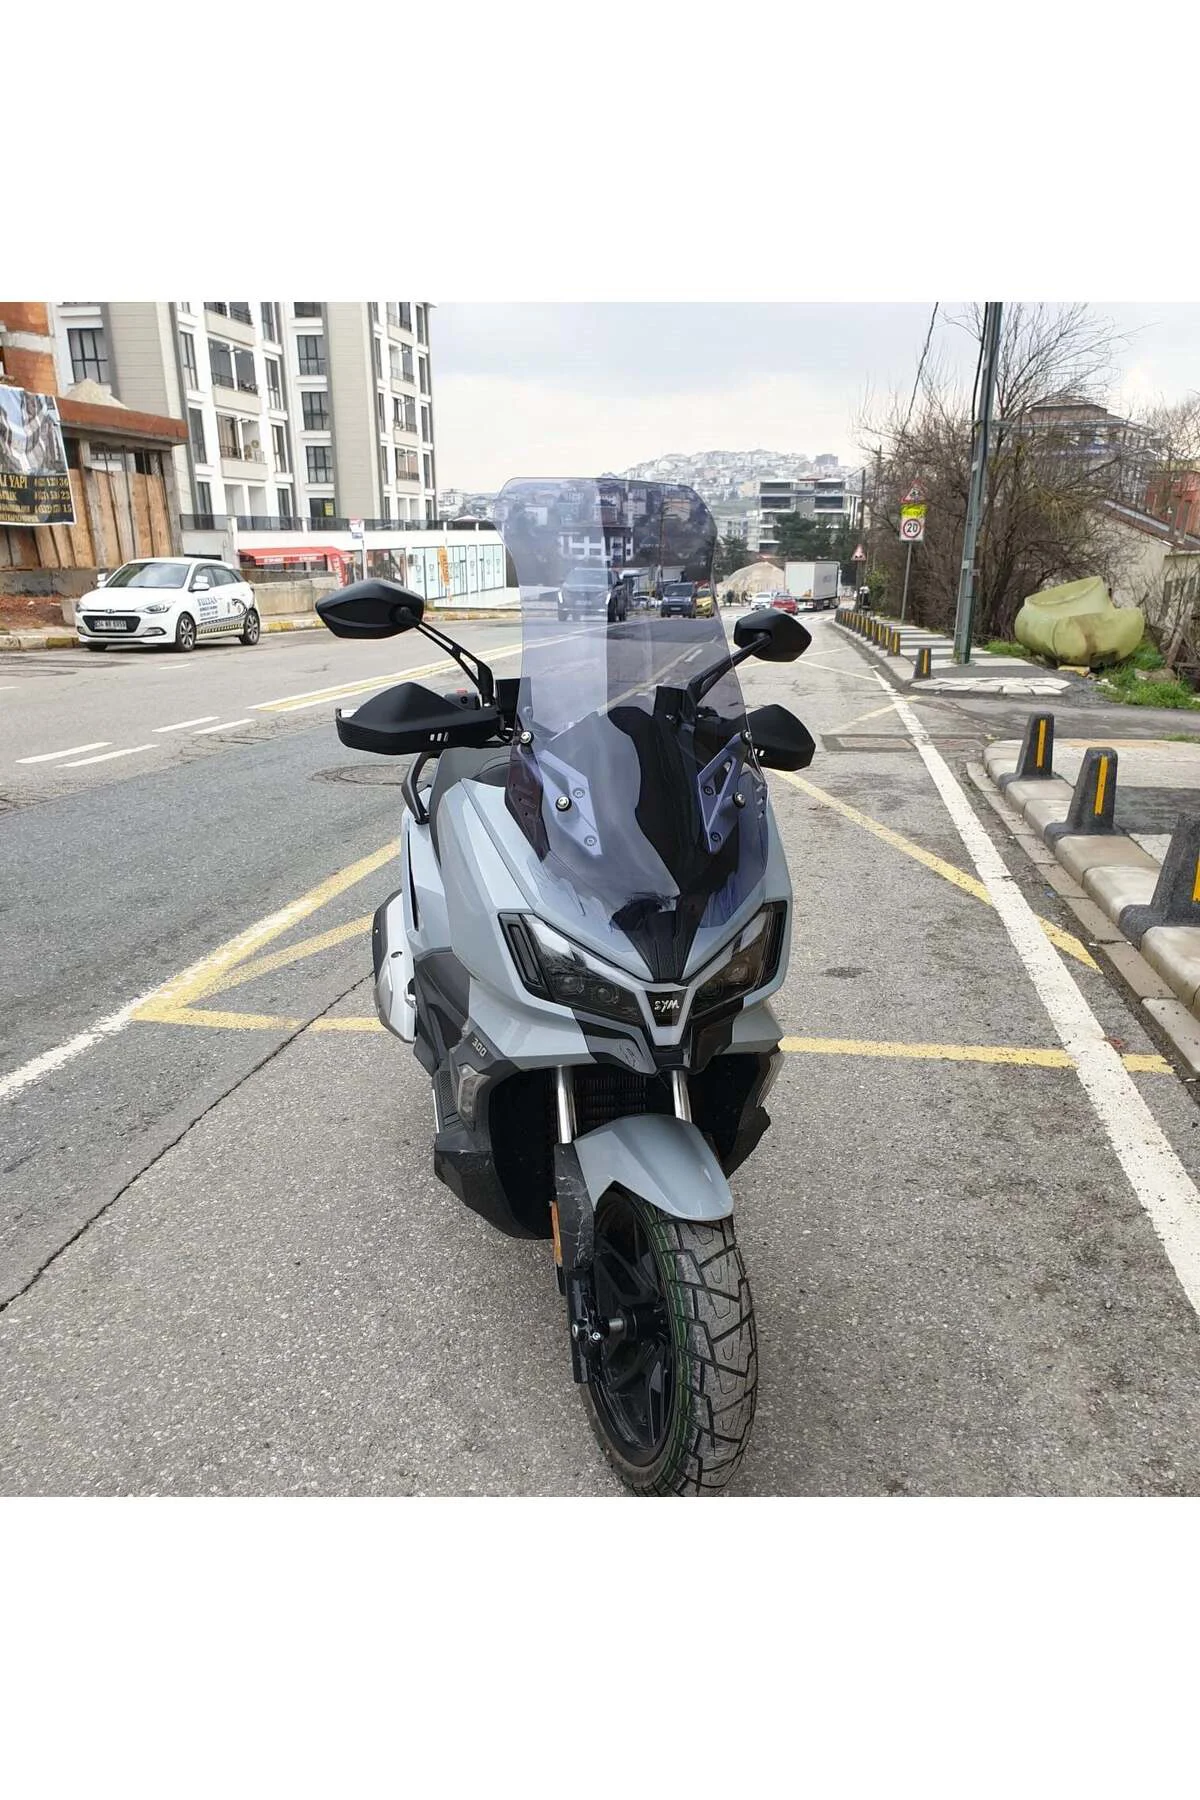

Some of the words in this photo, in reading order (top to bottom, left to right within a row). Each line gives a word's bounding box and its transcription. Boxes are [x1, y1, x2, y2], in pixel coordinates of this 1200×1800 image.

[9, 475, 28, 488] YAPI
[906, 522, 919, 533] 20
[654, 999, 680, 1013] SYM
[471, 1037, 487, 1057] 300
